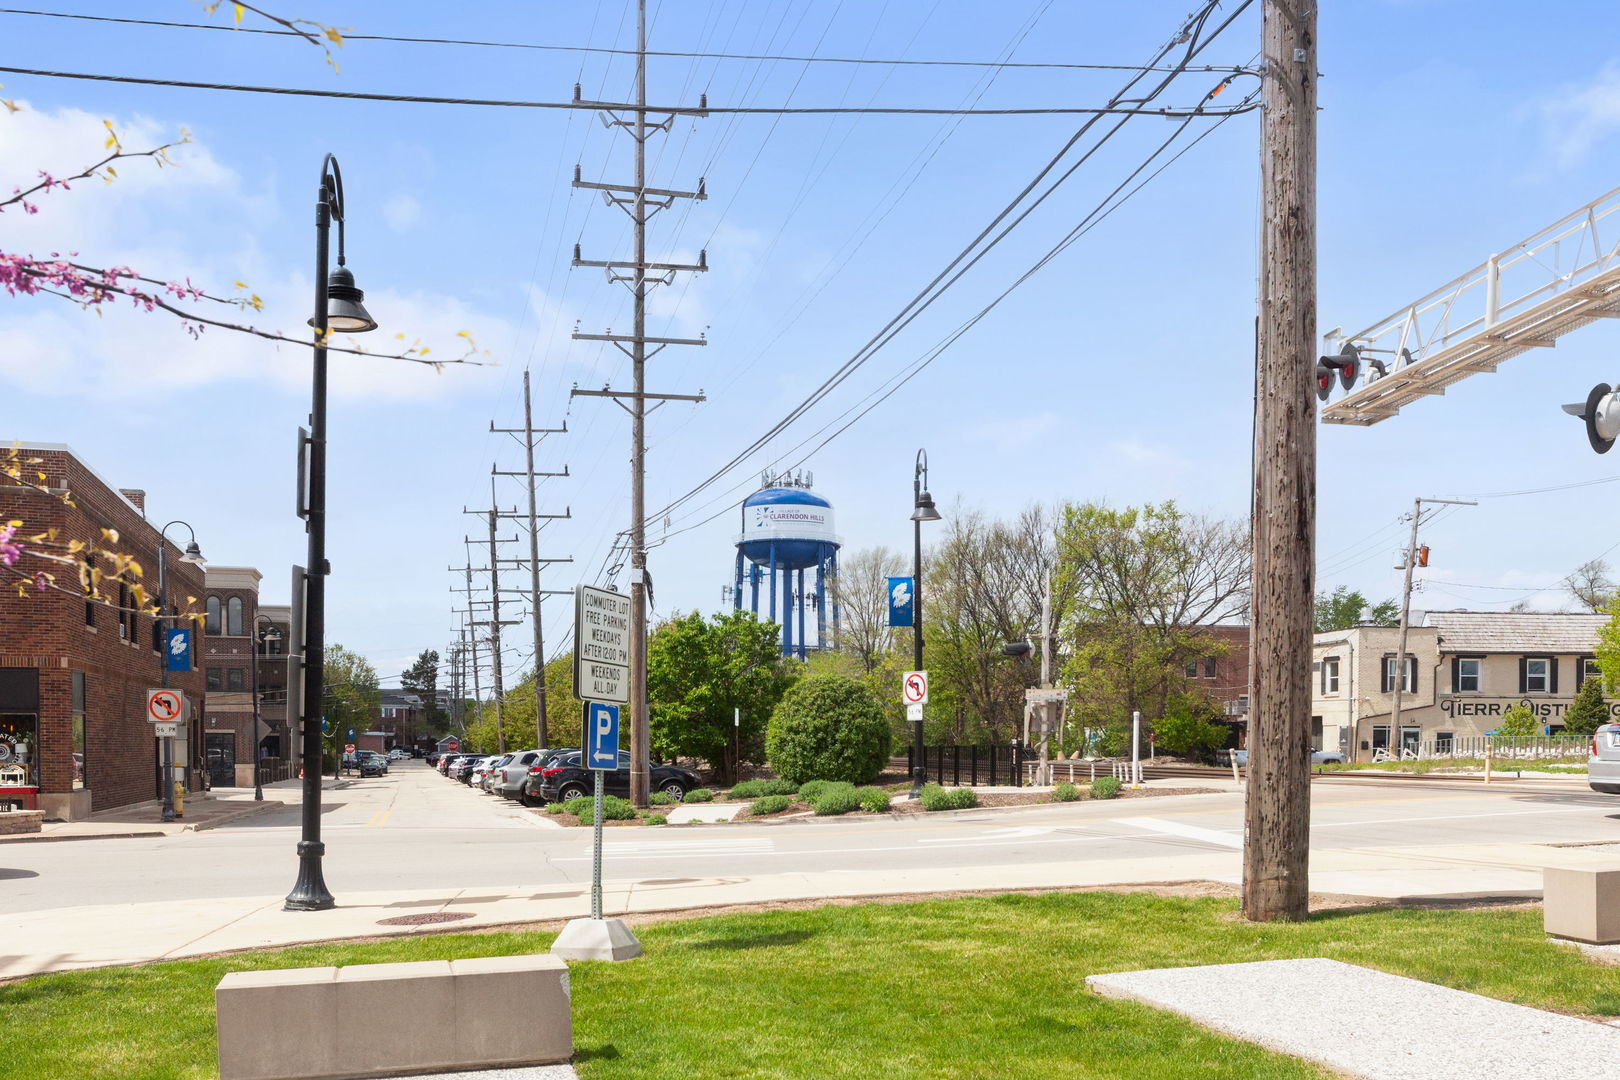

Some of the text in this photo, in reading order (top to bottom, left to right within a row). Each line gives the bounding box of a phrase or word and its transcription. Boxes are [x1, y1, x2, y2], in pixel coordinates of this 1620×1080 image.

[810, 514, 825, 522] HILLS
[585, 593, 629, 615] COMMUTER LOT
[585, 610, 627, 631] FREE PARKING
[591, 628, 621, 646] WEEKDAYS
[583, 643, 602, 659] AFTER
[618, 649, 628, 662] PM
[590, 664, 621, 681] WEEKENDS
[1440, 699, 1513, 719] TIERRA
[596, 709, 612, 749] P
